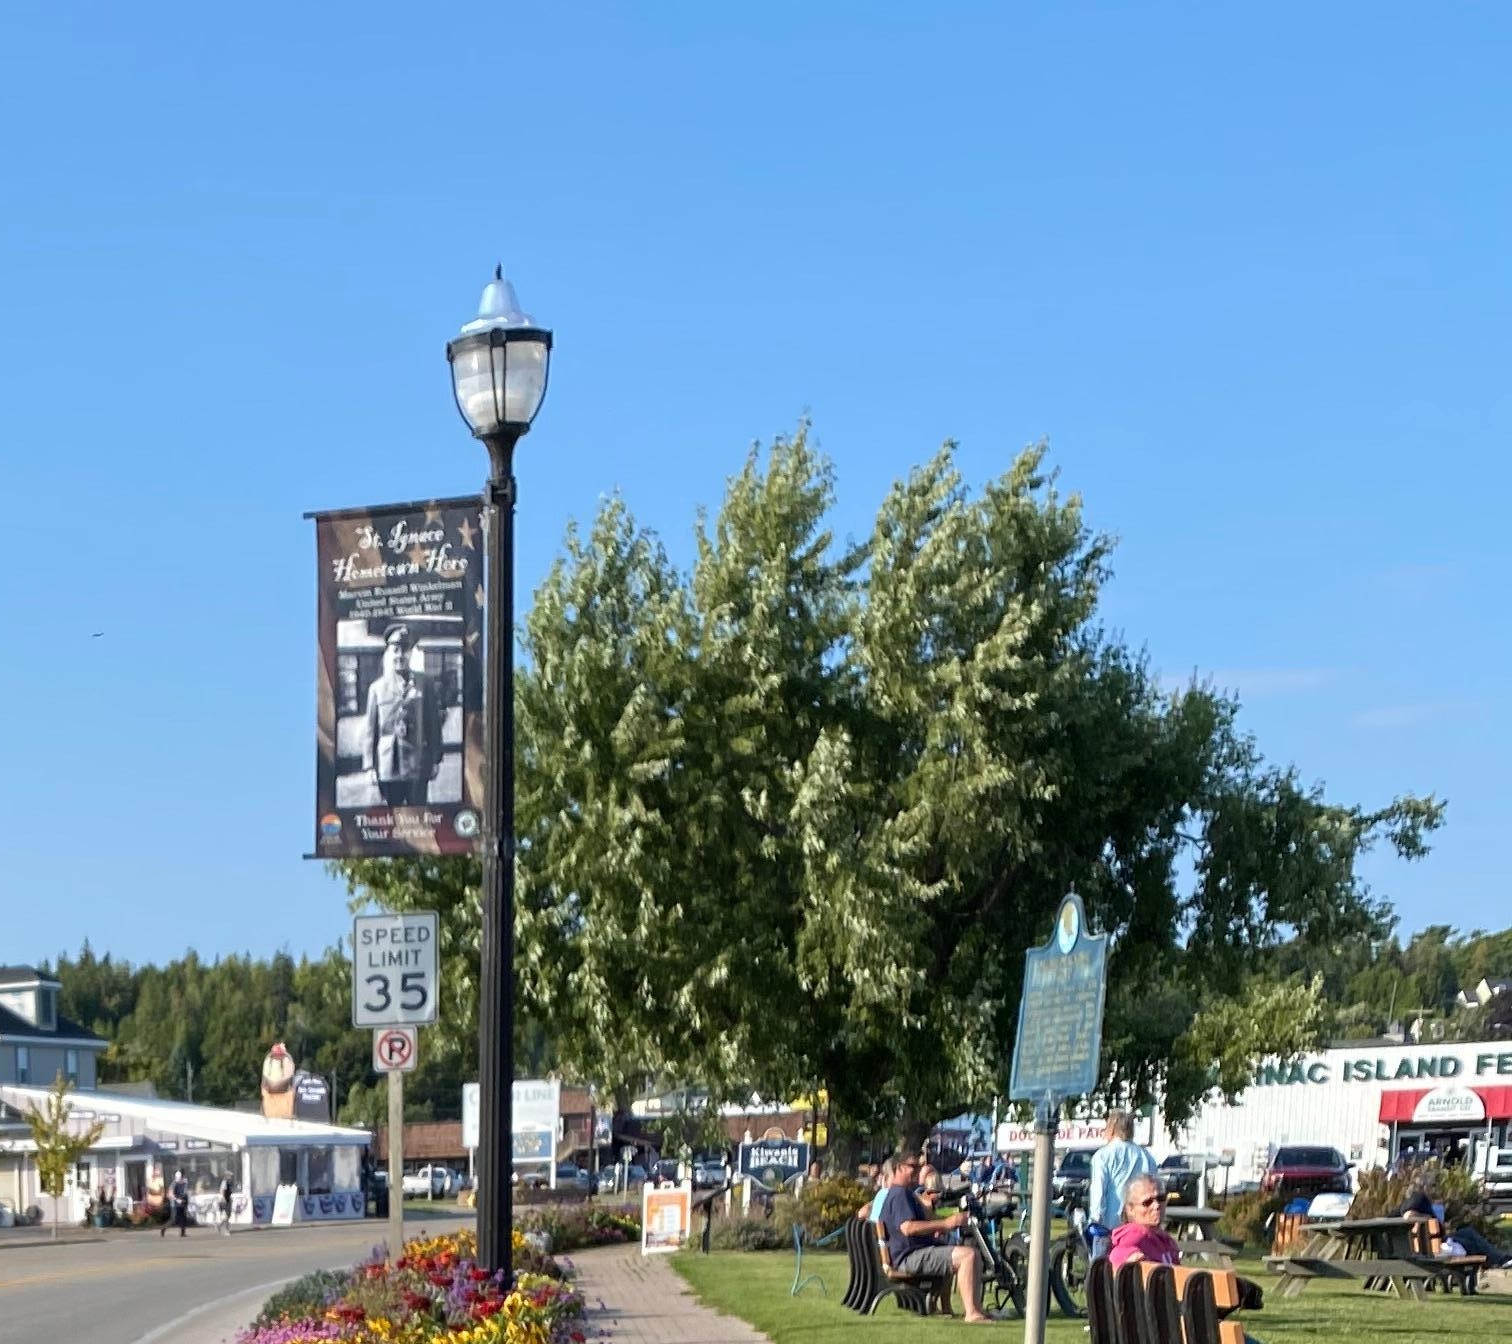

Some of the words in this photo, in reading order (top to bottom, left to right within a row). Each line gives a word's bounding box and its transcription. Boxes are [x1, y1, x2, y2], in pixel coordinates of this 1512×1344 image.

[354, 525, 384, 549] St.
[388, 520, 445, 554] Ignace
[332, 552, 420, 581] Hometown
[424, 543, 468, 573] Hero
[354, 813, 394, 828] Thank
[395, 812, 420, 825] You
[361, 926, 430, 945] SPEED
[368, 949, 421, 968] LIMIT
[364, 972, 427, 1012] 35
[388, 1037, 406, 1060] P
[1343, 1055, 1462, 1083] ISLAND
[1476, 1053, 1512, 1075] FE
[1428, 1096, 1473, 1106] ARNOLD
[750, 1156, 798, 1168] BEACH
